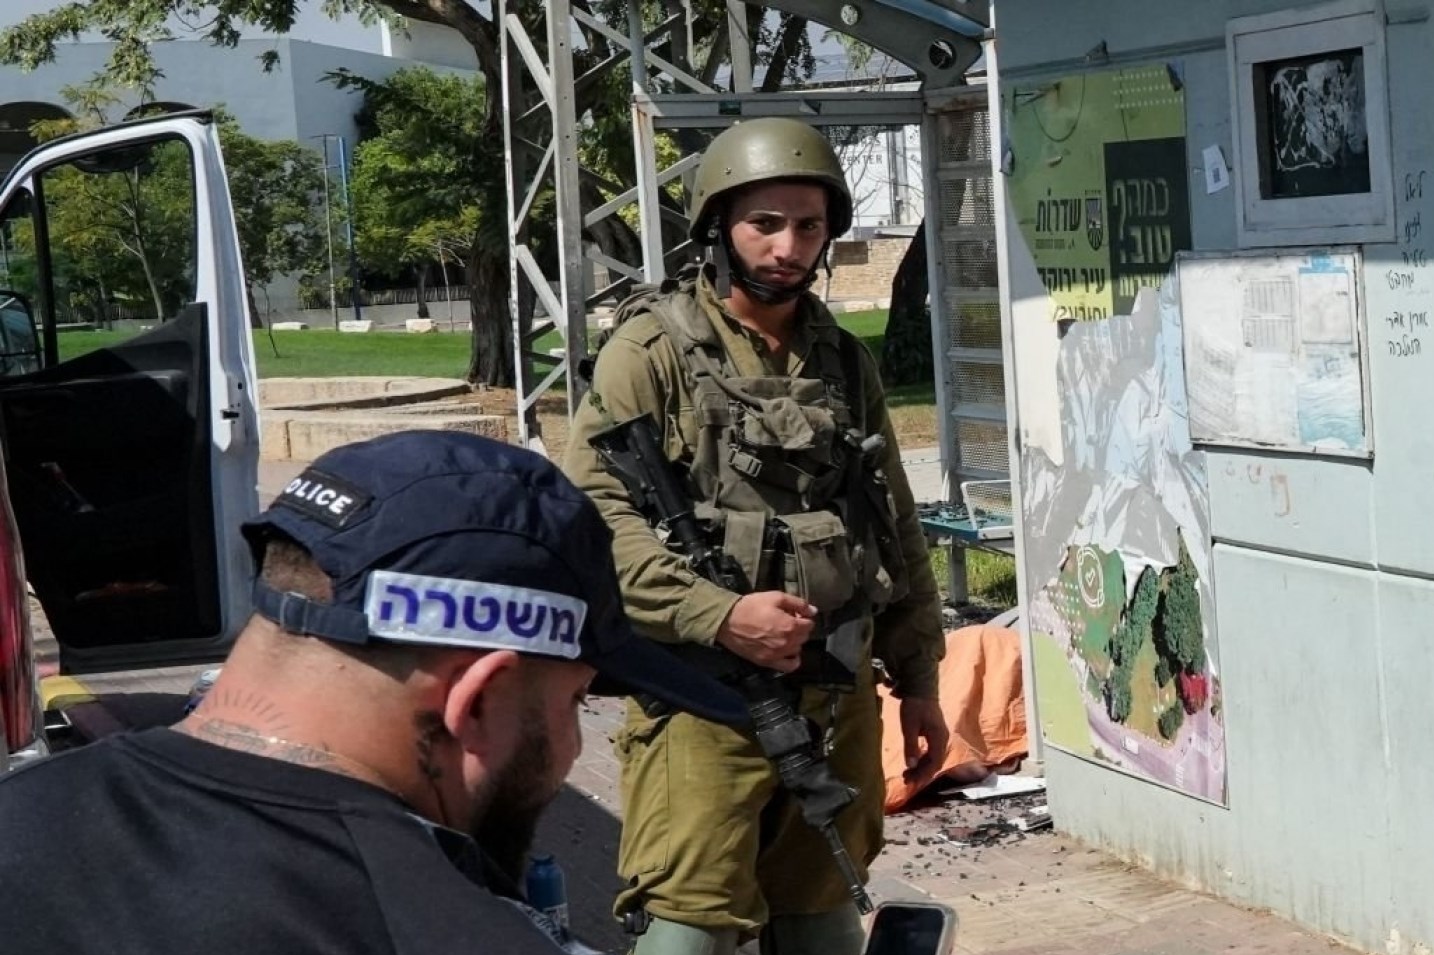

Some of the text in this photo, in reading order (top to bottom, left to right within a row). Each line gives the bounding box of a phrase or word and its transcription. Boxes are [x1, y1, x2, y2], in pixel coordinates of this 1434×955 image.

[1080, 268, 1105, 294] עיר
[285, 478, 352, 515] OLICE
[379, 584, 577, 645] משטרה
